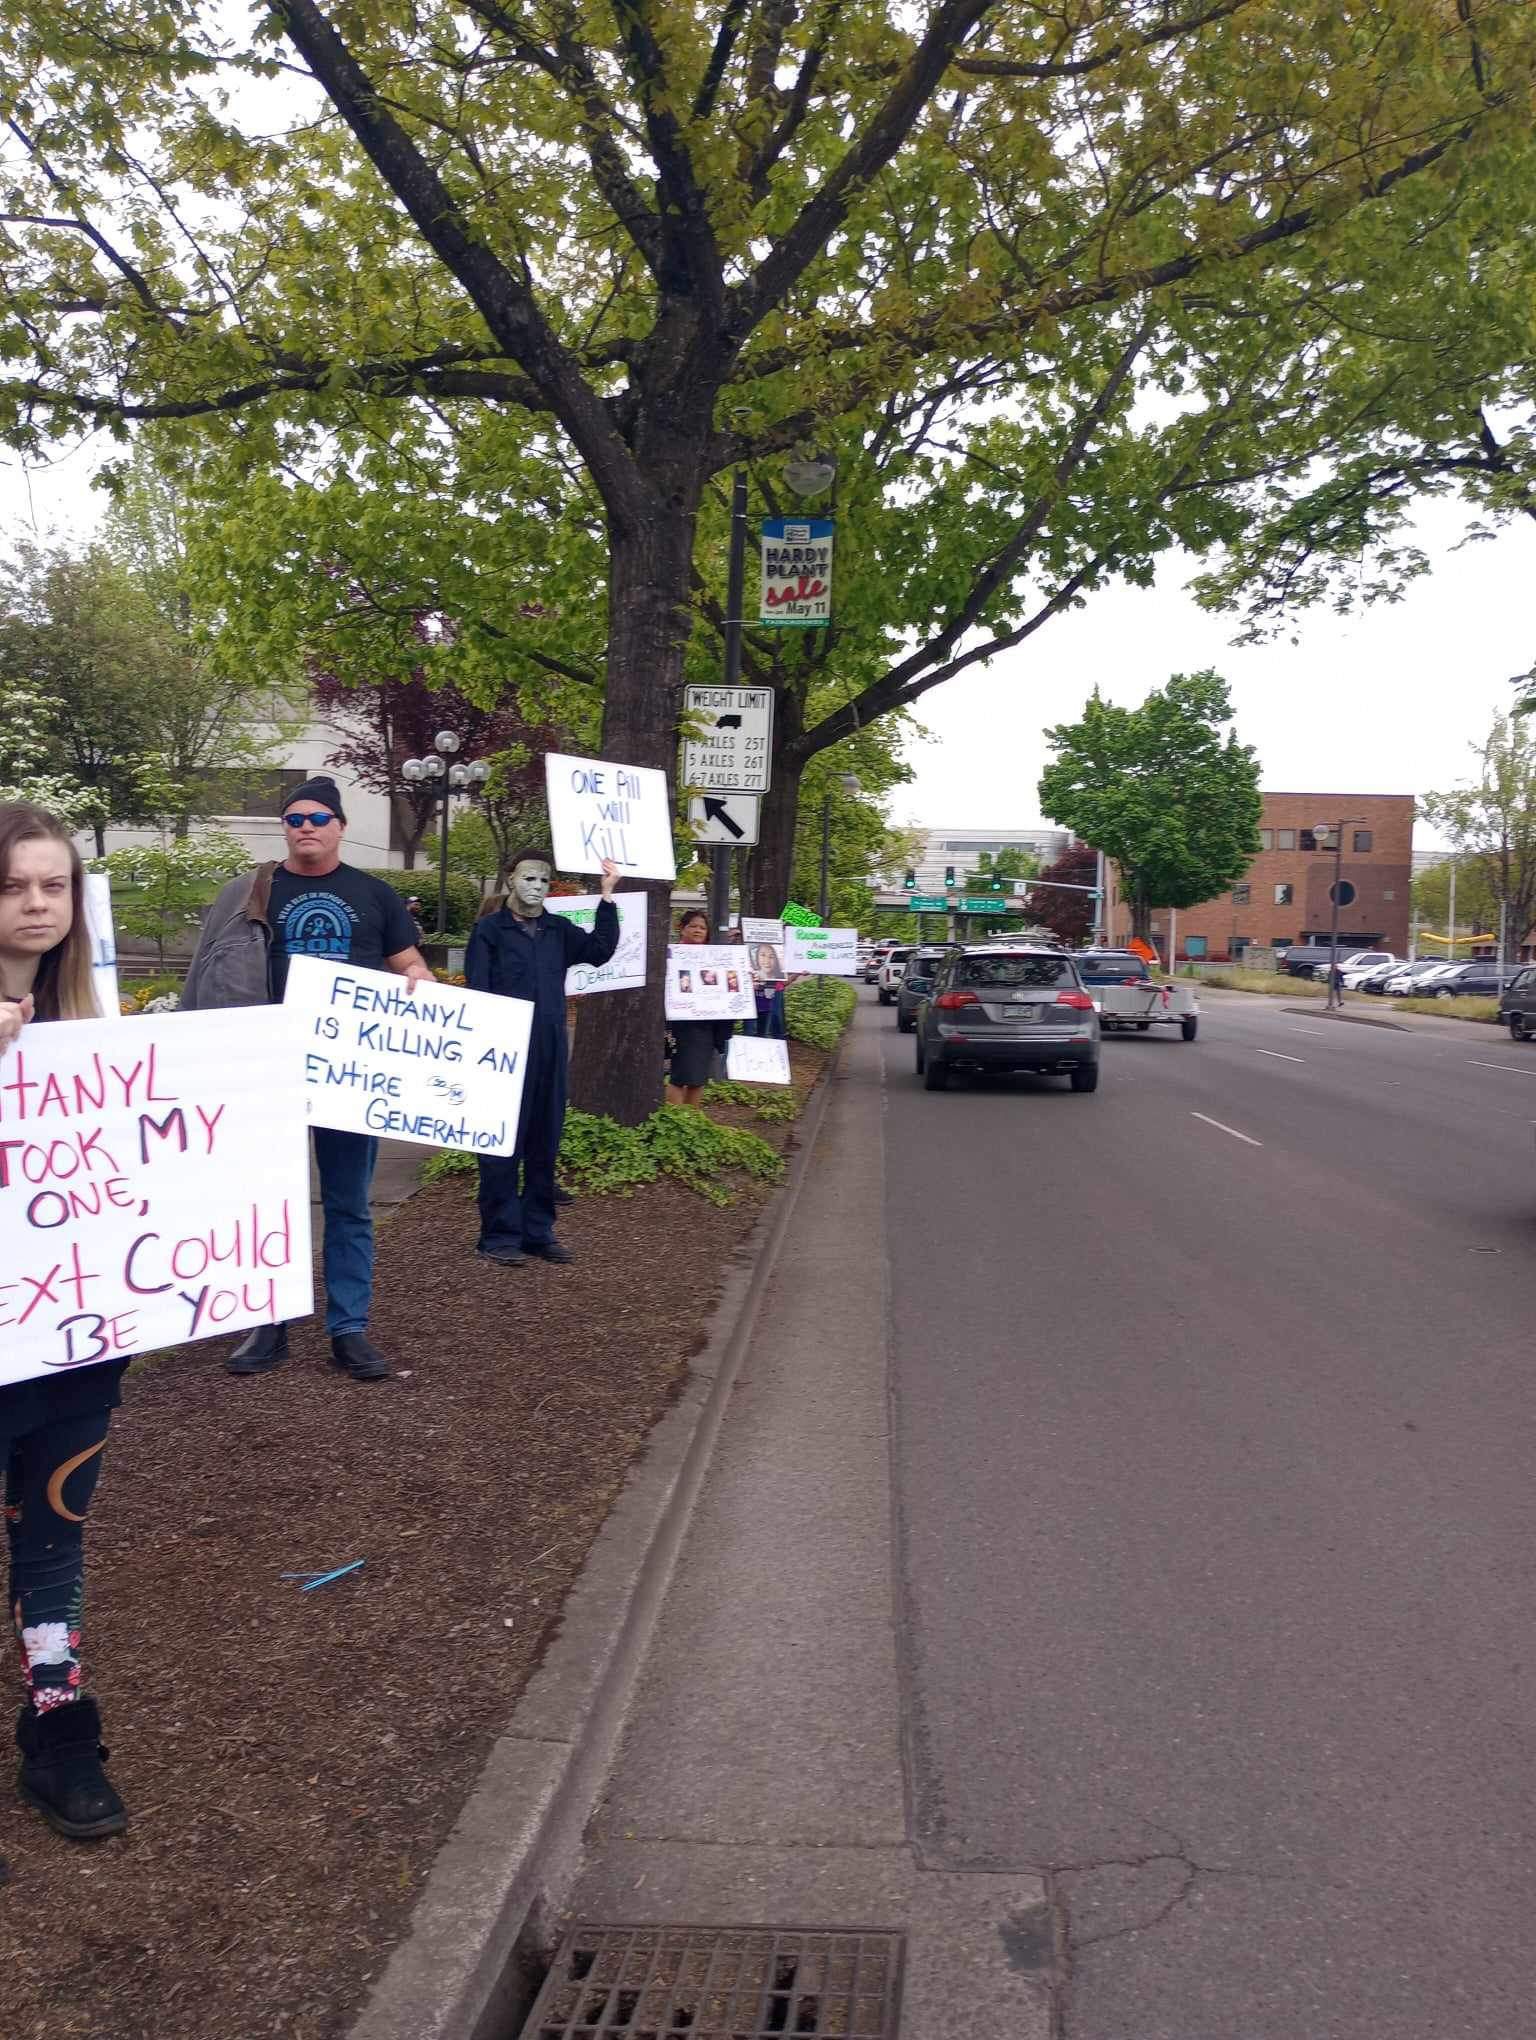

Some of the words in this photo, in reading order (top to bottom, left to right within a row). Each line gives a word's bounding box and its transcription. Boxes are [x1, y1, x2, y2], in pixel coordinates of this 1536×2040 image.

[766, 548, 829, 562] HARDY
[766, 564, 828, 577] PLANT
[767, 576, 828, 607] sale
[786, 602, 812, 616] May
[815, 602, 826, 614] 11
[691, 691, 733, 708] WEIGHT
[738, 692, 766, 709] LIMIT
[745, 737, 765, 750] 25T
[689, 753, 696, 766] 5
[700, 754, 735, 768] AXLES
[744, 755, 764, 769] 26T
[571, 769, 605, 794] ONE
[708, 773, 740, 786] AXLES
[744, 774, 763, 787] 27T
[286, 939, 351, 953] SON
[331, 976, 474, 1031] FENTANYL
[314, 1017, 340, 1039] IS
[358, 1021, 463, 1062] KILLING
[477, 1047, 518, 1074] AN
[138, 1104, 225, 1164] MY
[365, 1097, 505, 1148] GENERATION
[0, 1127, 119, 1188] TOOK
[27, 1177, 149, 1228] ONE,
[41, 1309, 140, 1366] BE
